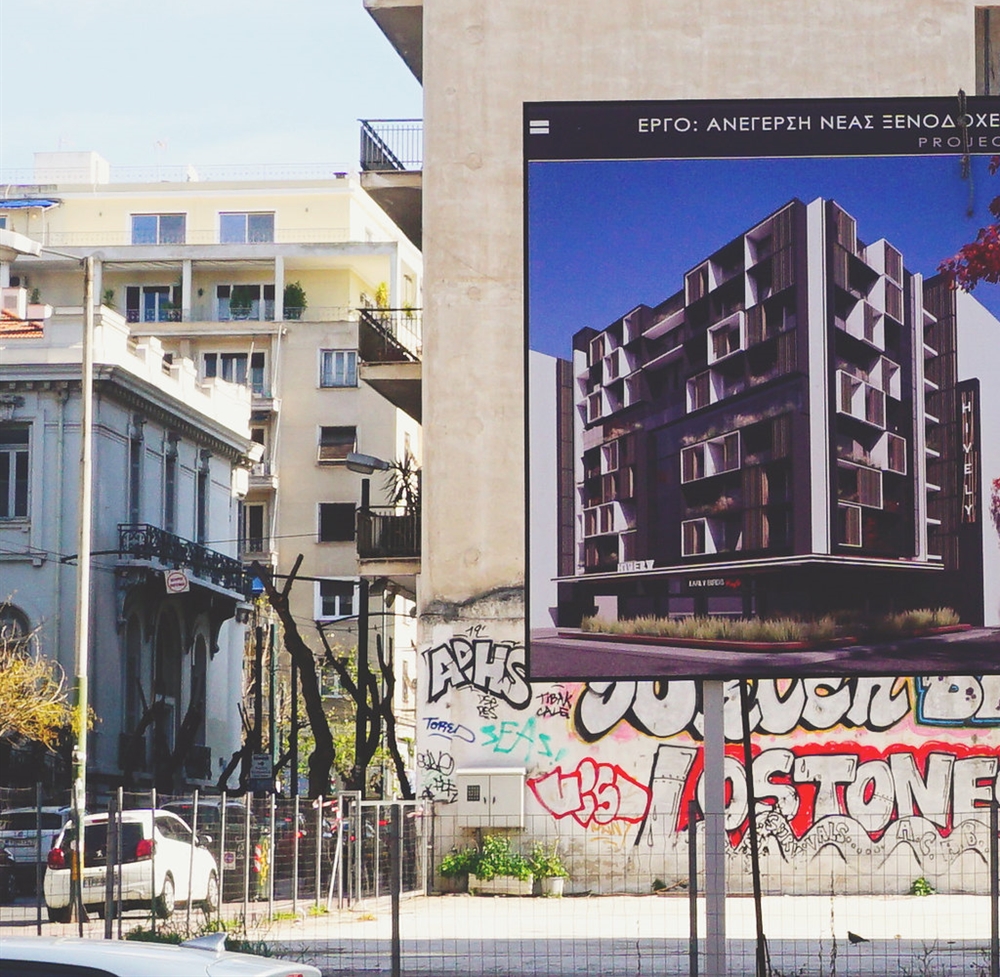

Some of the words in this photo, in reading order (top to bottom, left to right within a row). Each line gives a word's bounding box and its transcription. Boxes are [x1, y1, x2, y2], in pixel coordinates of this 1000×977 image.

[638, 117, 698, 133] ΕΡΓΟ:
[706, 115, 811, 132] ΑΝΕΓΕΡΣΗ
[820, 114, 874, 130] ΝΕΑΣ
[961, 401, 974, 516] HIVELY
